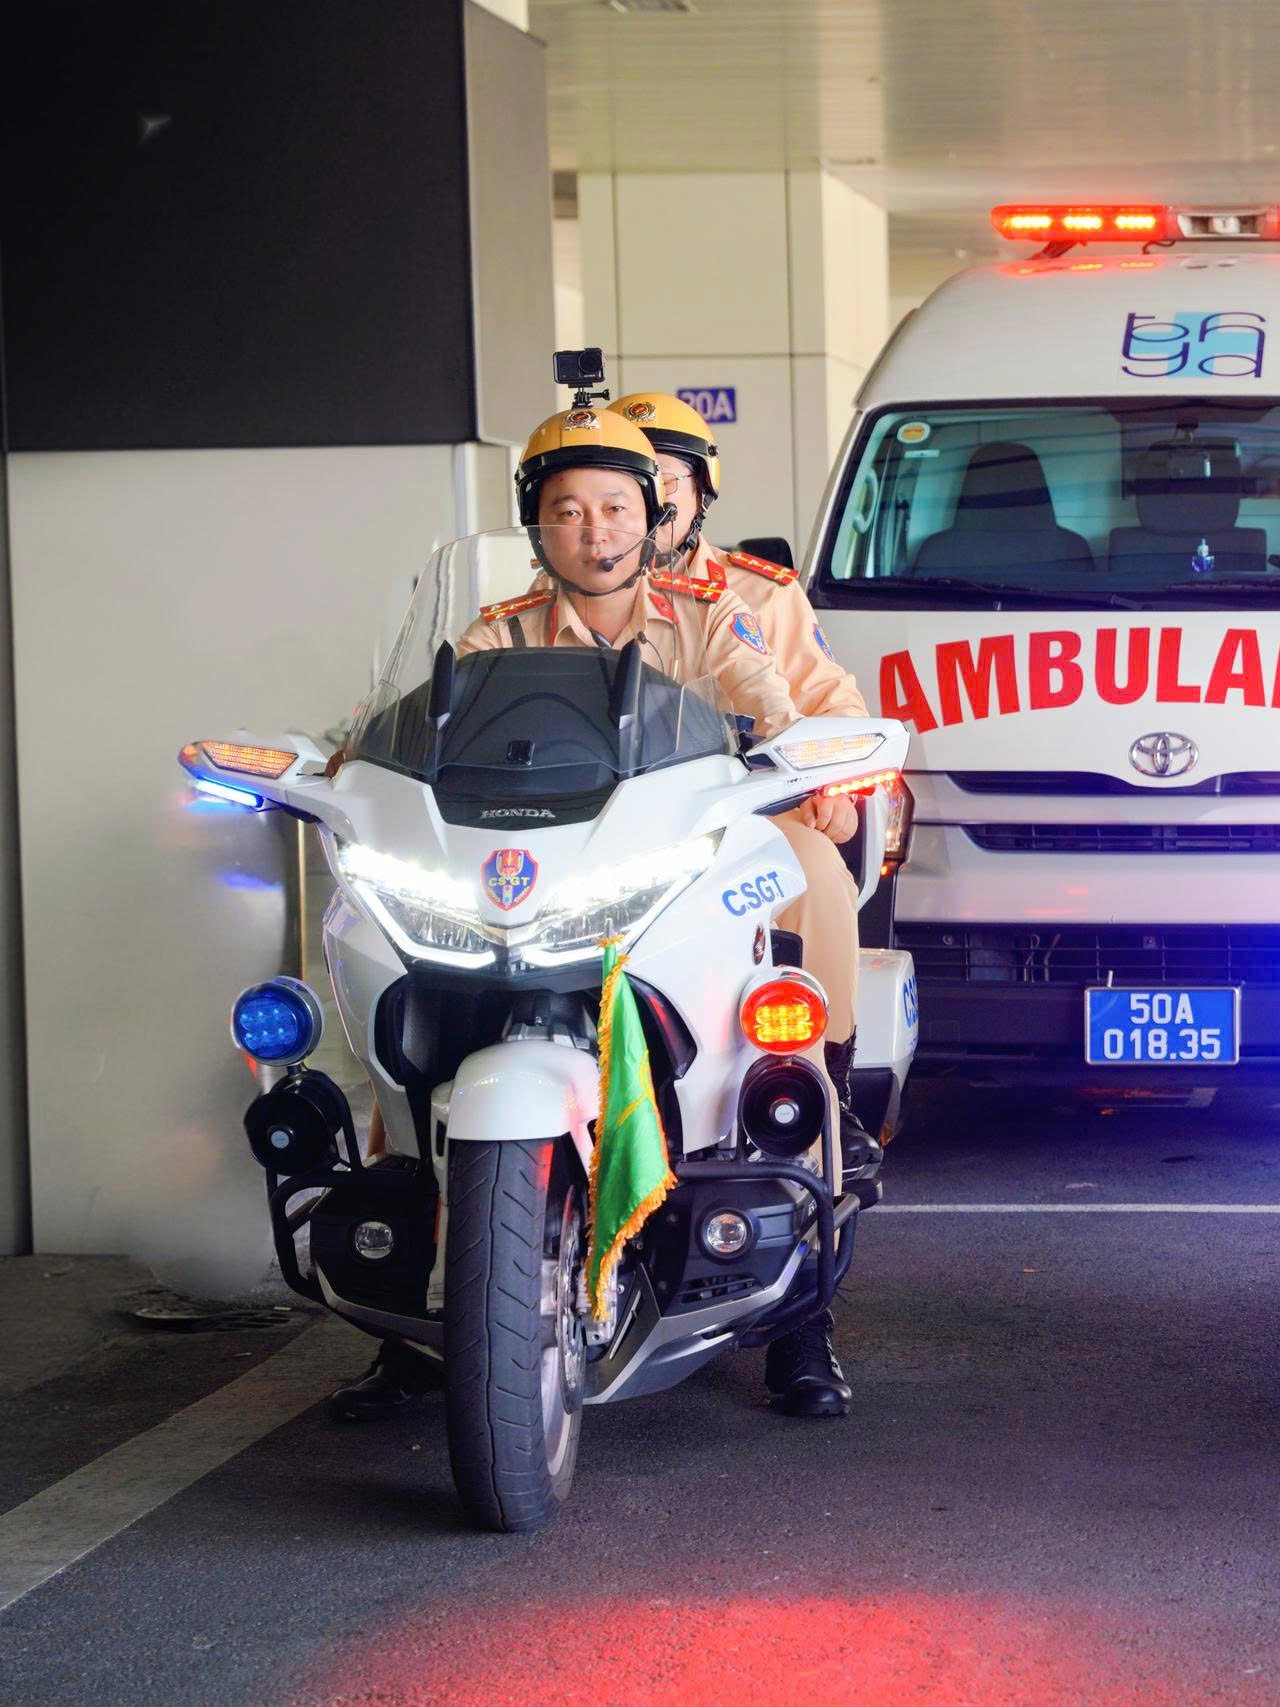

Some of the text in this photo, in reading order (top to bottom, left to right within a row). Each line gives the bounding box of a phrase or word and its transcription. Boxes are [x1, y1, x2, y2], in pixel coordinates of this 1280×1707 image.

[480, 808, 556, 819] HONDA
[1130, 993, 1194, 1025] 50A
[1103, 1028, 1221, 1060] 018.35
